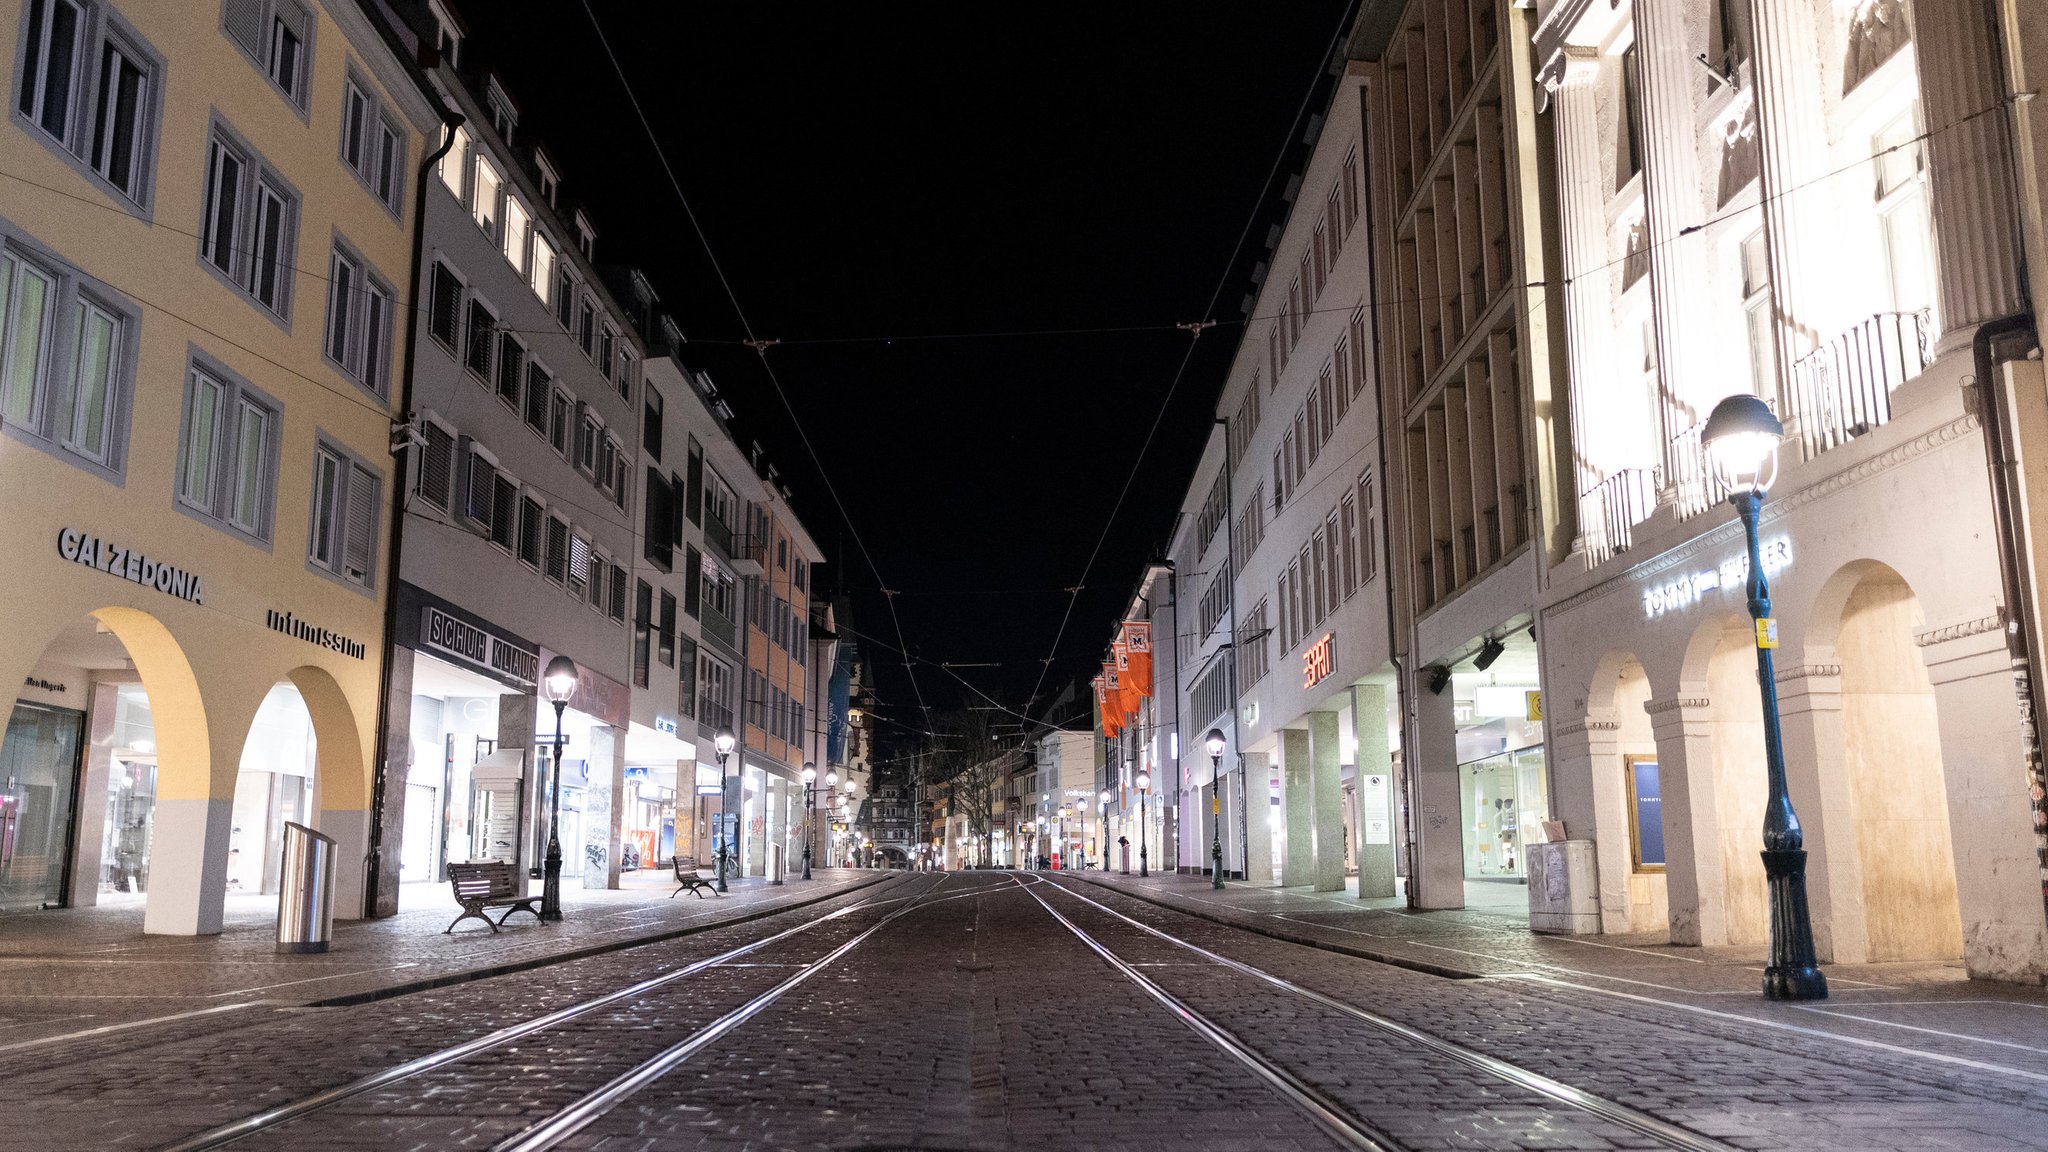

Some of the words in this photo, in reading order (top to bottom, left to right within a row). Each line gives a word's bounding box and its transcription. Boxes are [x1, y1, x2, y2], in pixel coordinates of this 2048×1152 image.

[57, 527, 205, 605] CALZEDONIA
[1643, 576, 1697, 614] TOMMY
[267, 609, 366, 660] intimissimi
[433, 615, 486, 659] SCHUH
[493, 642, 538, 680] KLAUS
[1303, 632, 1330, 689] ESPRIT
